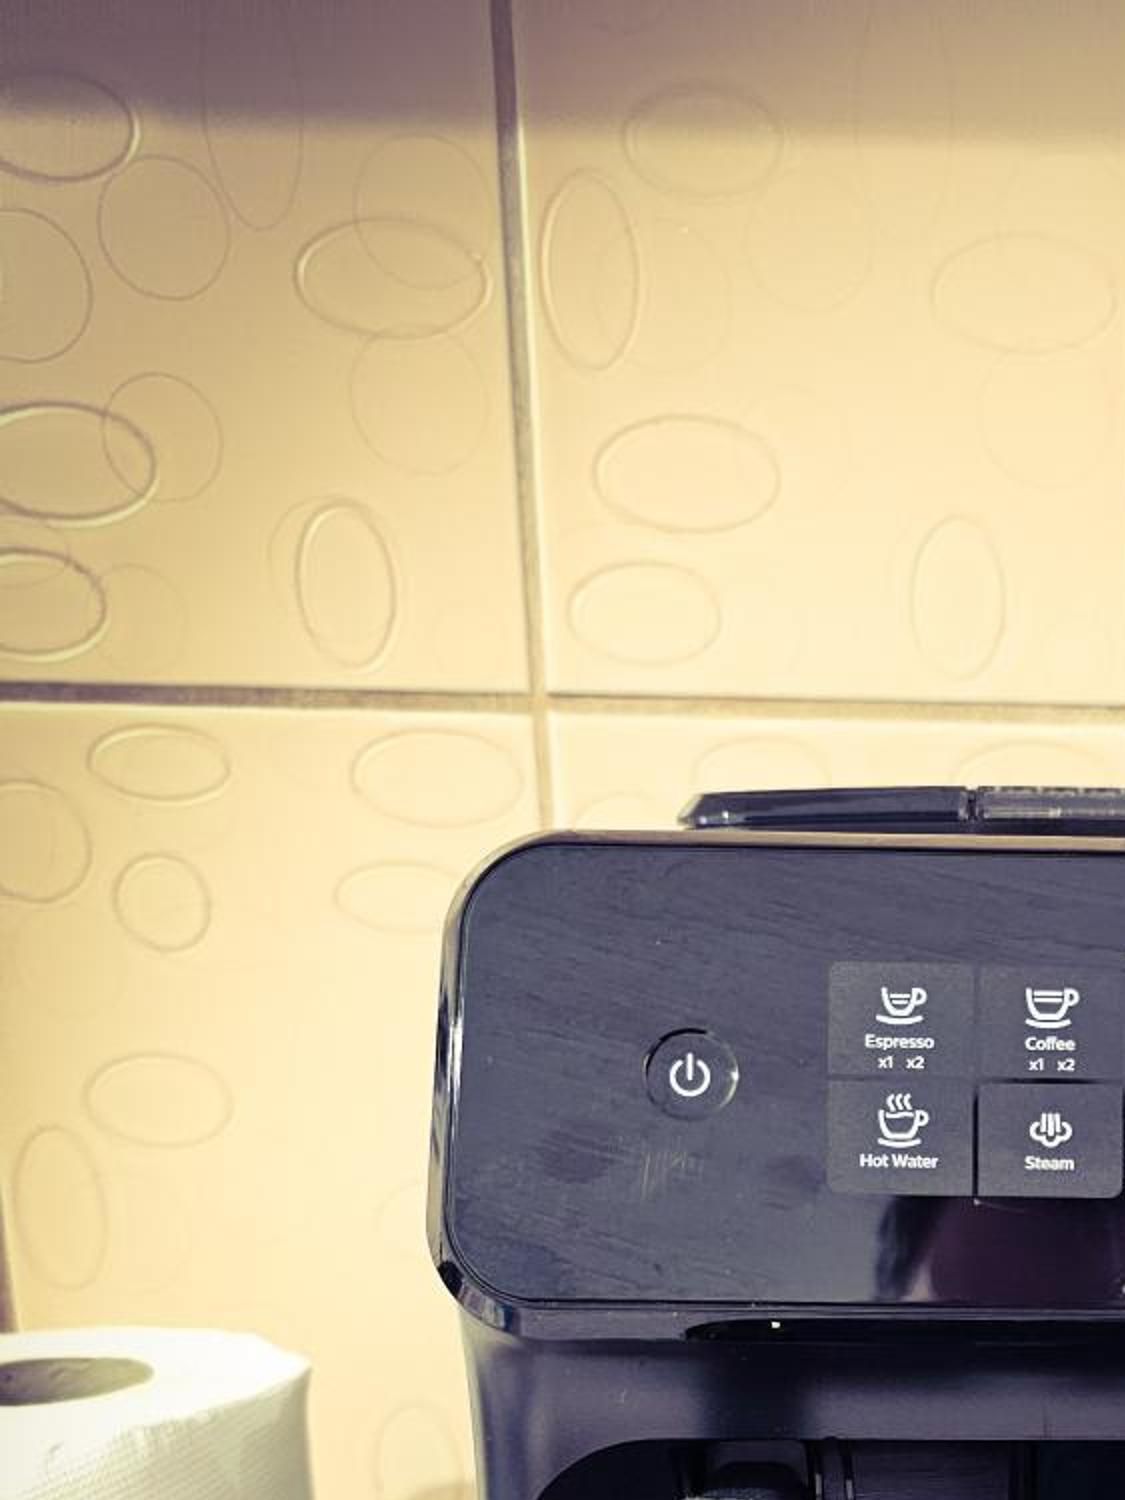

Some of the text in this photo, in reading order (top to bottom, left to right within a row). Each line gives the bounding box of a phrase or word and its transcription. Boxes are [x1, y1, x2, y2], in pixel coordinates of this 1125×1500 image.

[865, 1034, 935, 1051] Espresso
[1025, 1036, 1075, 1051] Coffee
[878, 1055, 925, 1069] x1 x2
[1028, 1057, 1075, 1072] x1 x2
[859, 1153, 938, 1168] Hot Water
[1024, 1156, 1075, 1170] Steam
